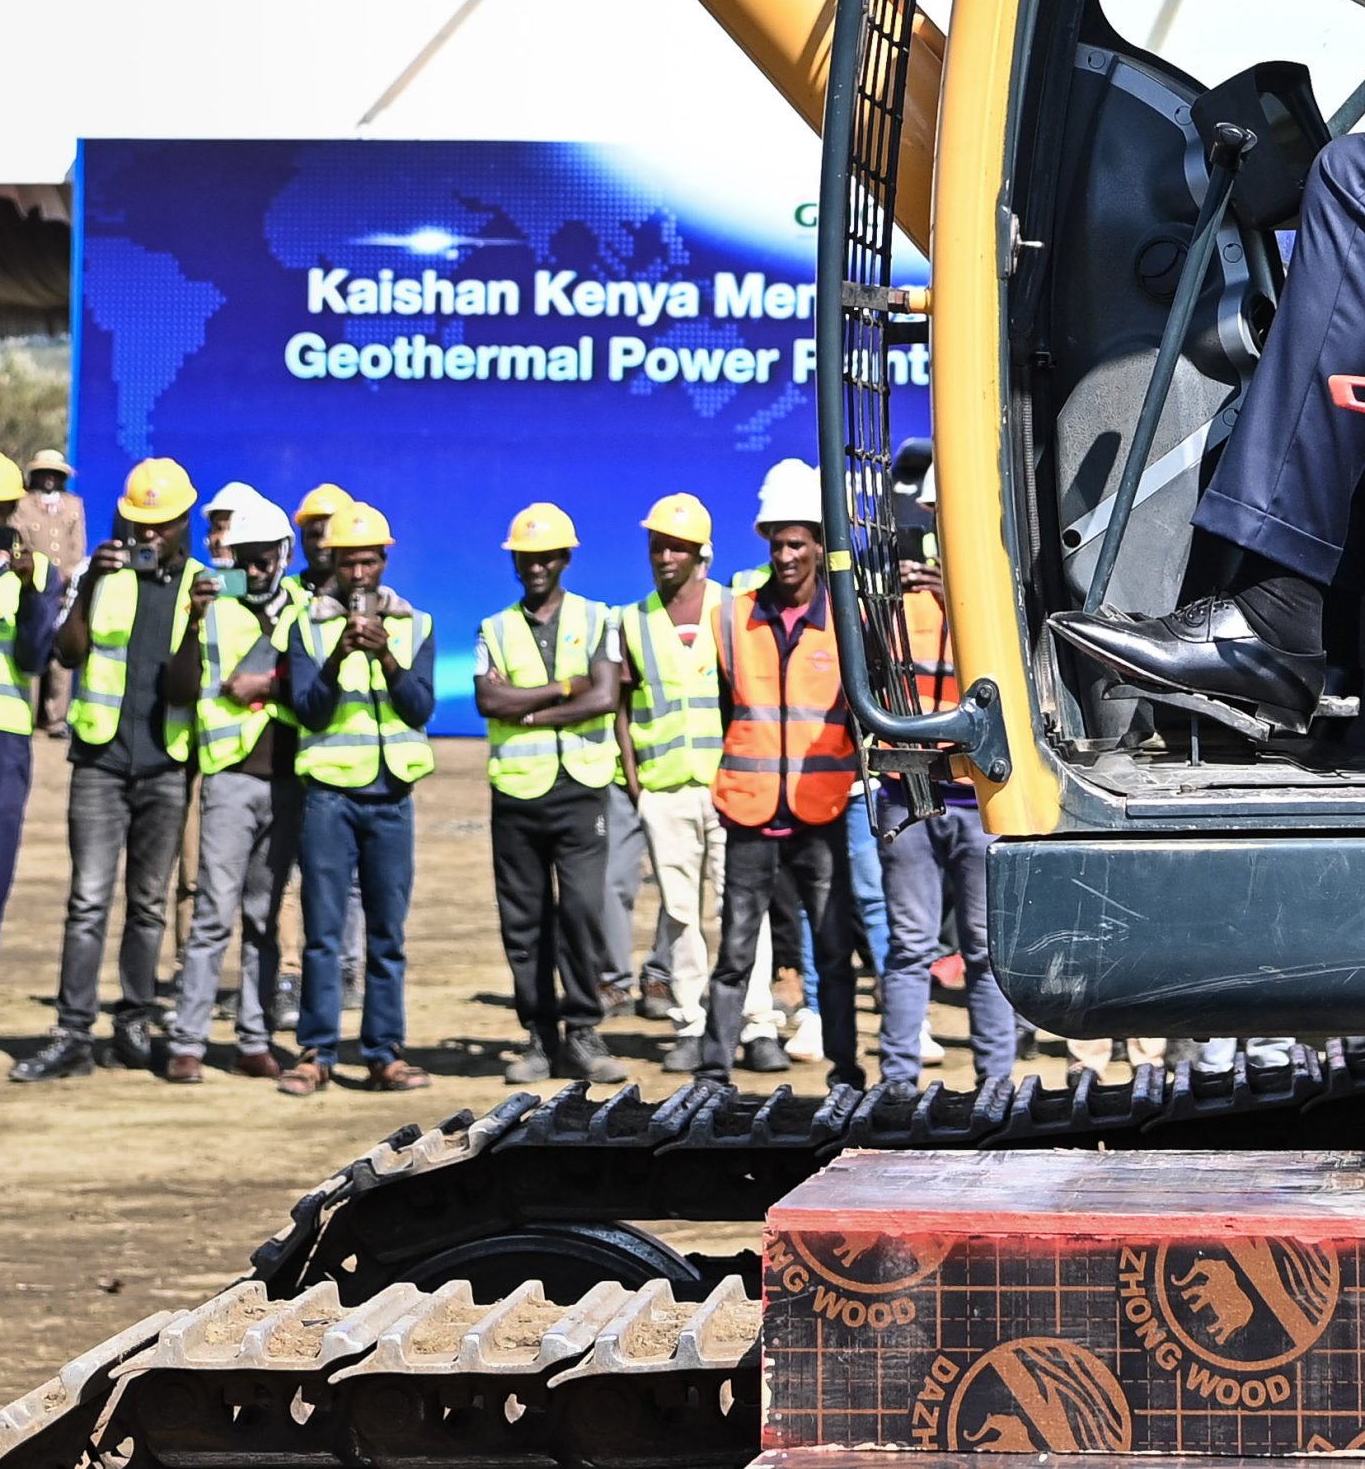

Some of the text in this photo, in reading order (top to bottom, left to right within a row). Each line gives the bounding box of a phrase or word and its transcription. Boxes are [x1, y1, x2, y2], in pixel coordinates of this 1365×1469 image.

[307, 267, 520, 315] Kaishan
[535, 269, 700, 327] Kenya
[283, 331, 594, 382] Geothermal
[608, 335, 780, 385] Power
[812, 1285, 917, 1329] WOOD
[1118, 1246, 1291, 1408] ZHONG WOOD
